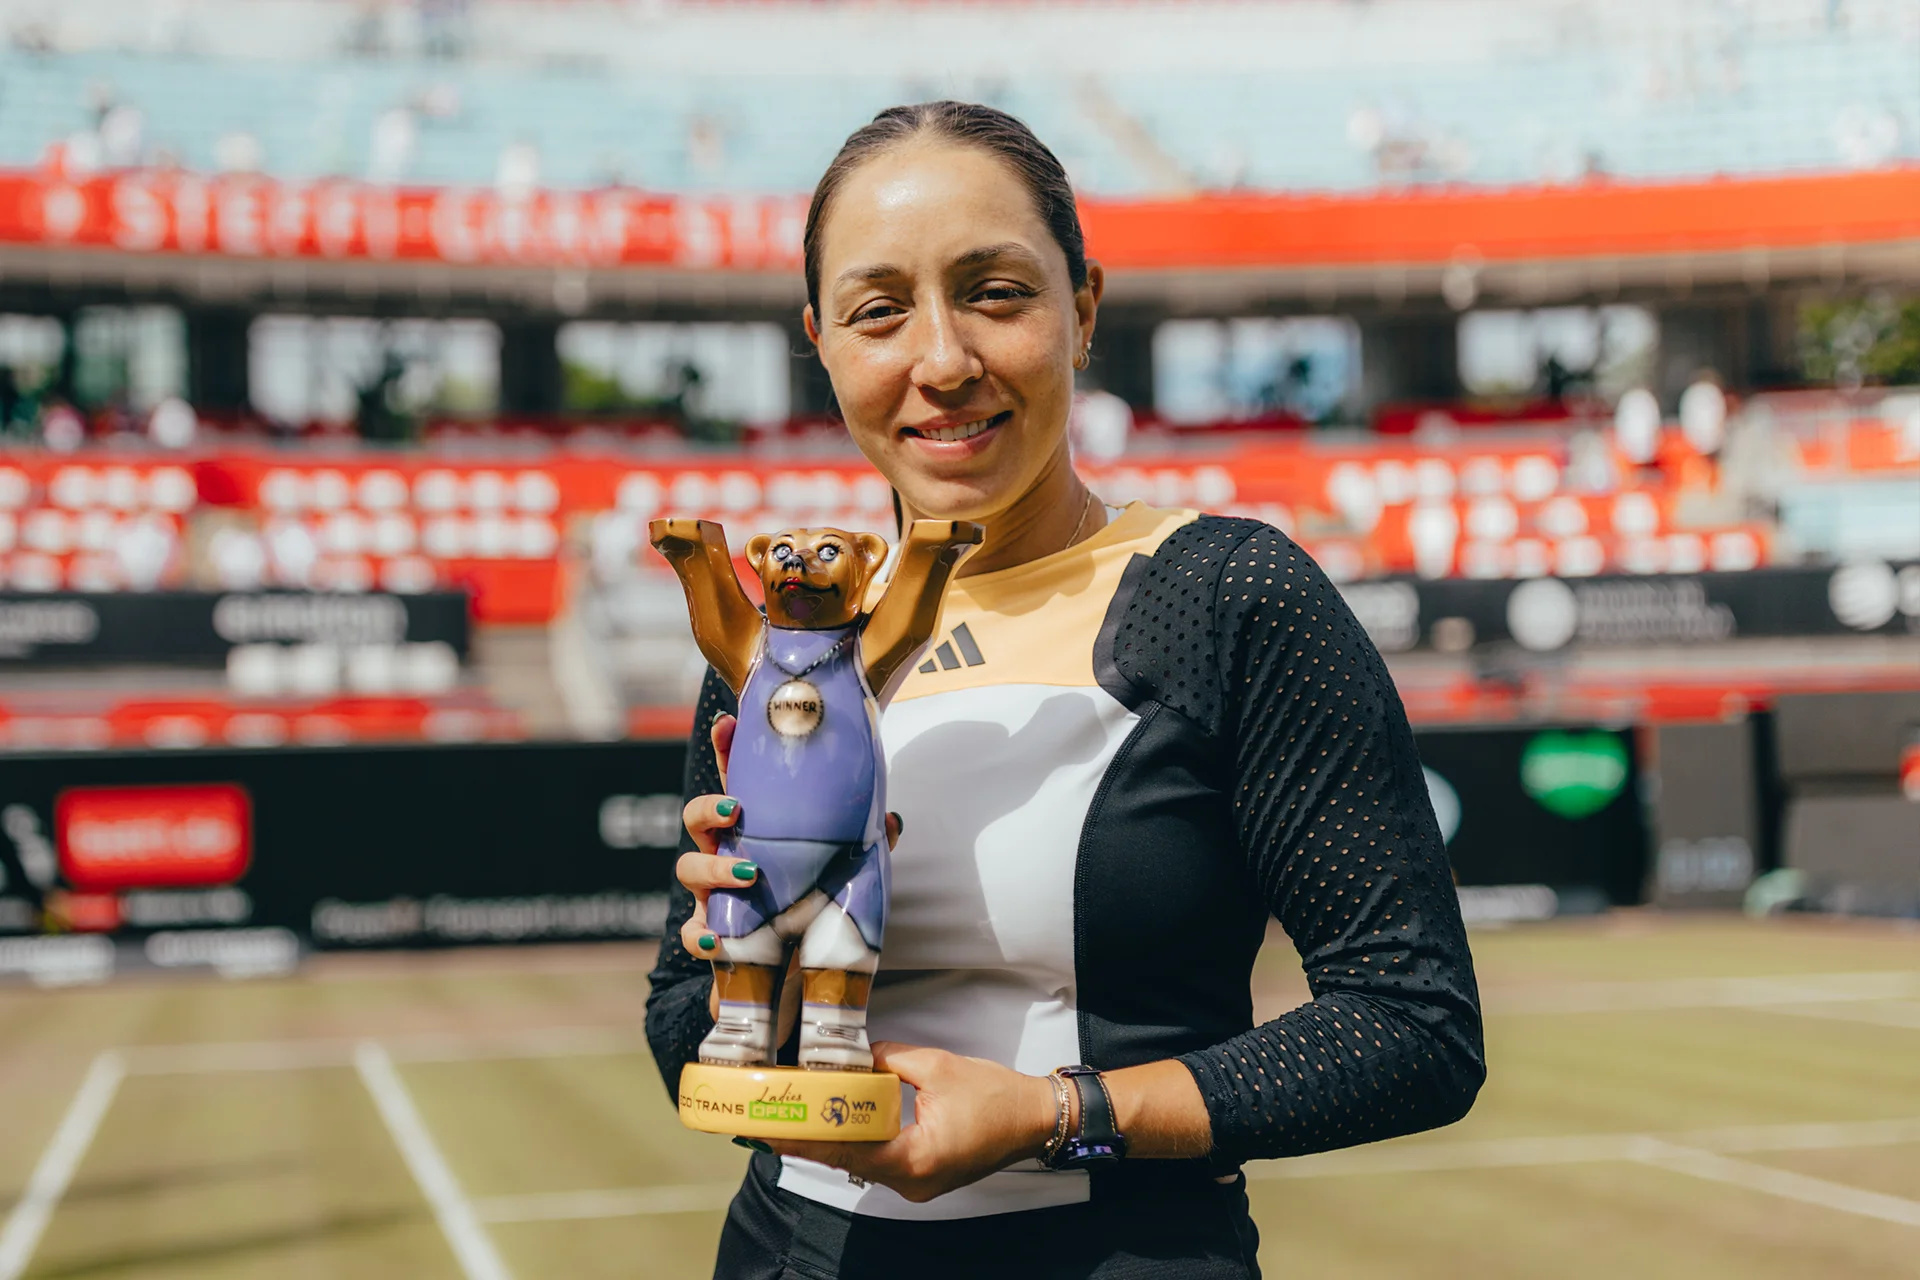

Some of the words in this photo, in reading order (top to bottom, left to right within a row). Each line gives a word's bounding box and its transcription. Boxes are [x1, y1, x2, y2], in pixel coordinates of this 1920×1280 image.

[773, 700, 817, 713] WINNER
[755, 1082, 802, 1105] Ladies
[695, 1099, 745, 1116] TRANS
[752, 1103, 804, 1119] OPEN
[852, 1101, 877, 1112] WTA
[851, 1113, 871, 1125] 500
